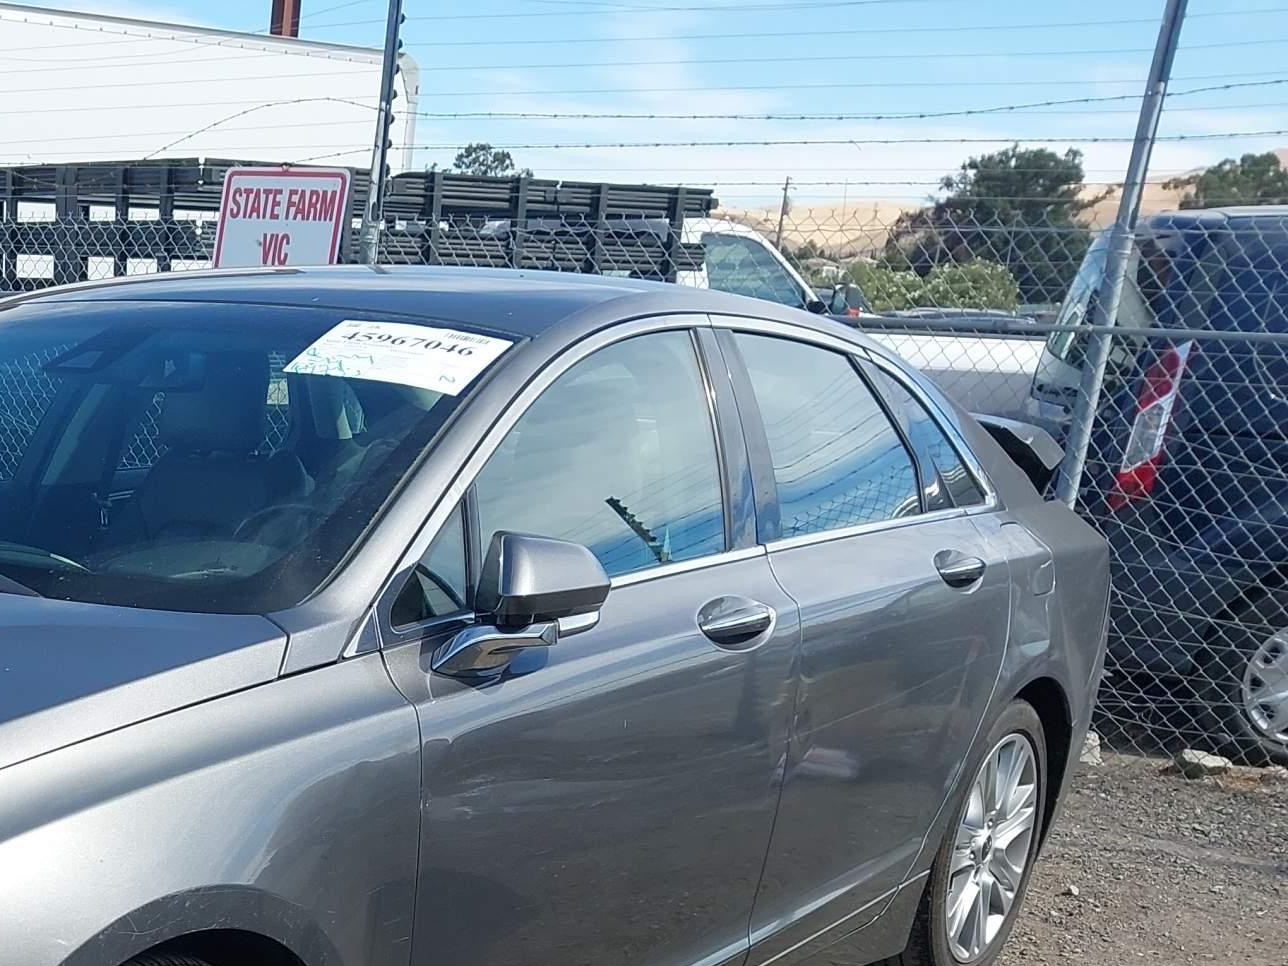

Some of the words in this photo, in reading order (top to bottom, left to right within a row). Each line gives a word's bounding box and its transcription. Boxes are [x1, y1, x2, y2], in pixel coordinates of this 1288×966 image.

[229, 187, 283, 220] STATE
[284, 189, 338, 222] FARM
[261, 233, 290, 265] VIC
[341, 331, 474, 357] 45967046
